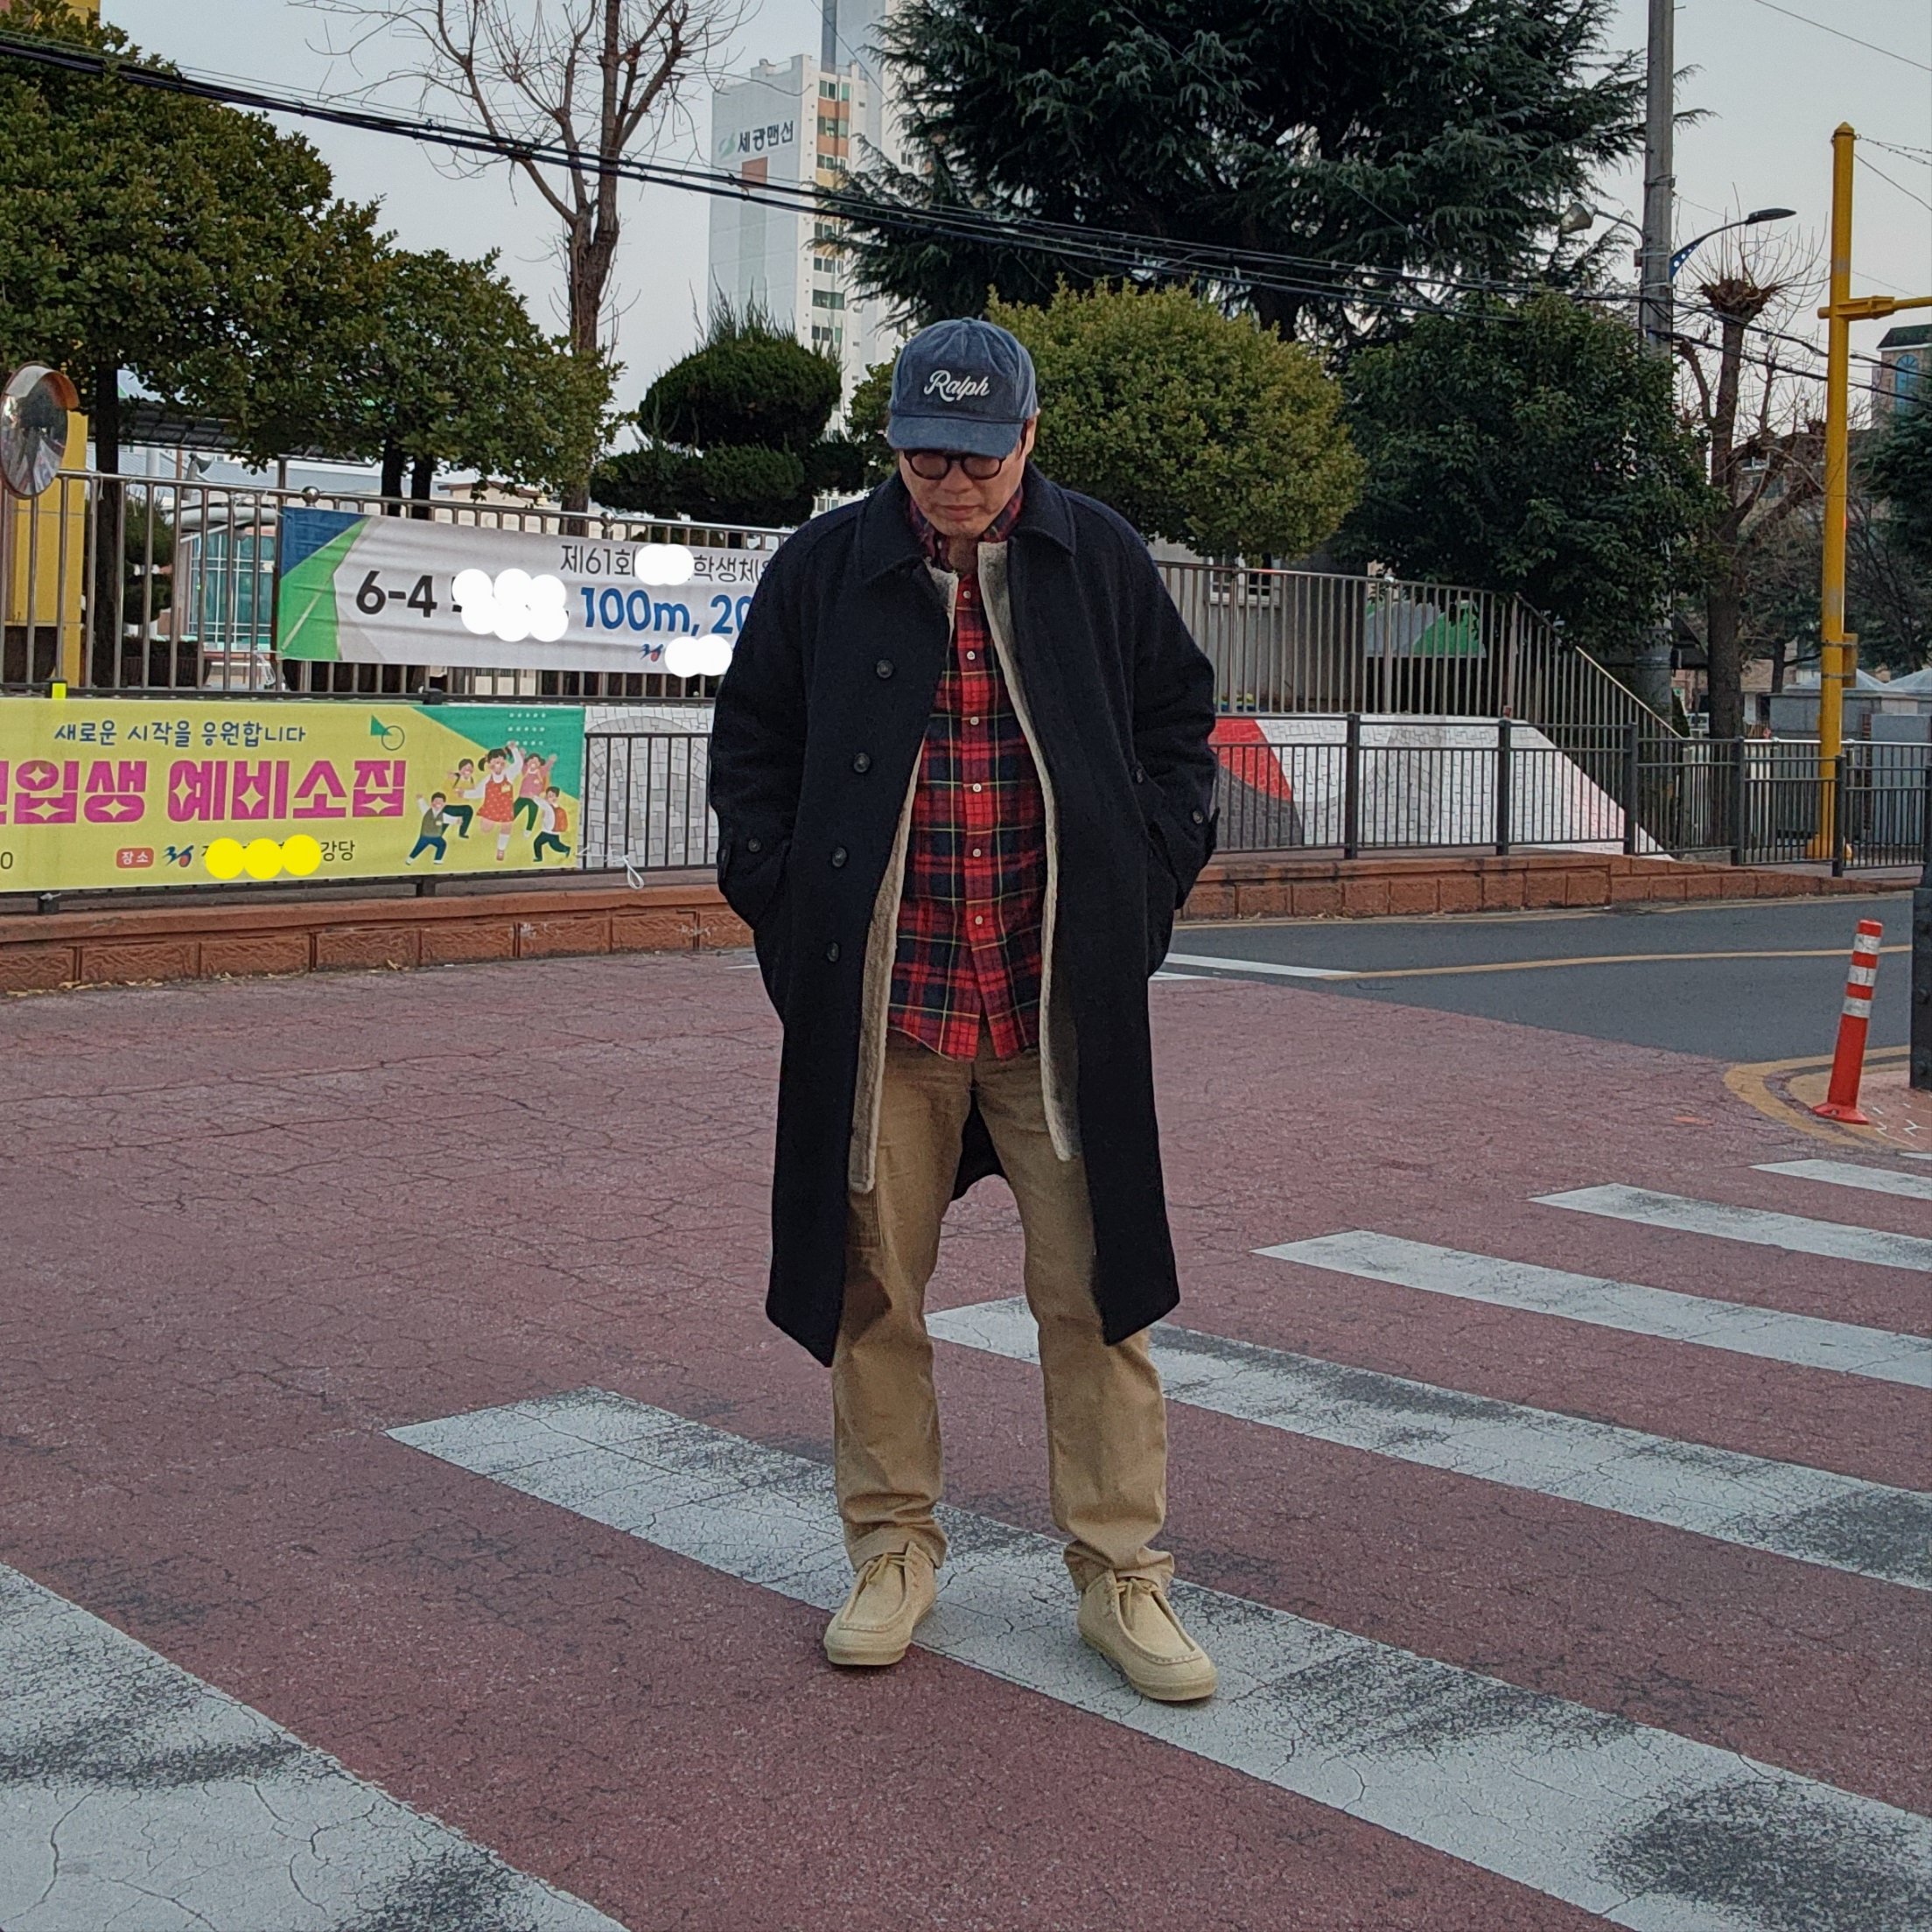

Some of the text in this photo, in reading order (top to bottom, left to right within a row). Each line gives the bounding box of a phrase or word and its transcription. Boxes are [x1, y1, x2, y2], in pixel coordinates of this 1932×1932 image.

[737, 120, 794, 153] 세광맨션
[923, 369, 990, 402] Ralph
[560, 544, 636, 578] 제61회
[356, 570, 438, 619] 6-4
[581, 586, 700, 636] 100m,
[54, 720, 306, 747] 새로운 시작을 응원합니다
[167, 760, 406, 822] 예비소집
[321, 840, 356, 862] 강당
